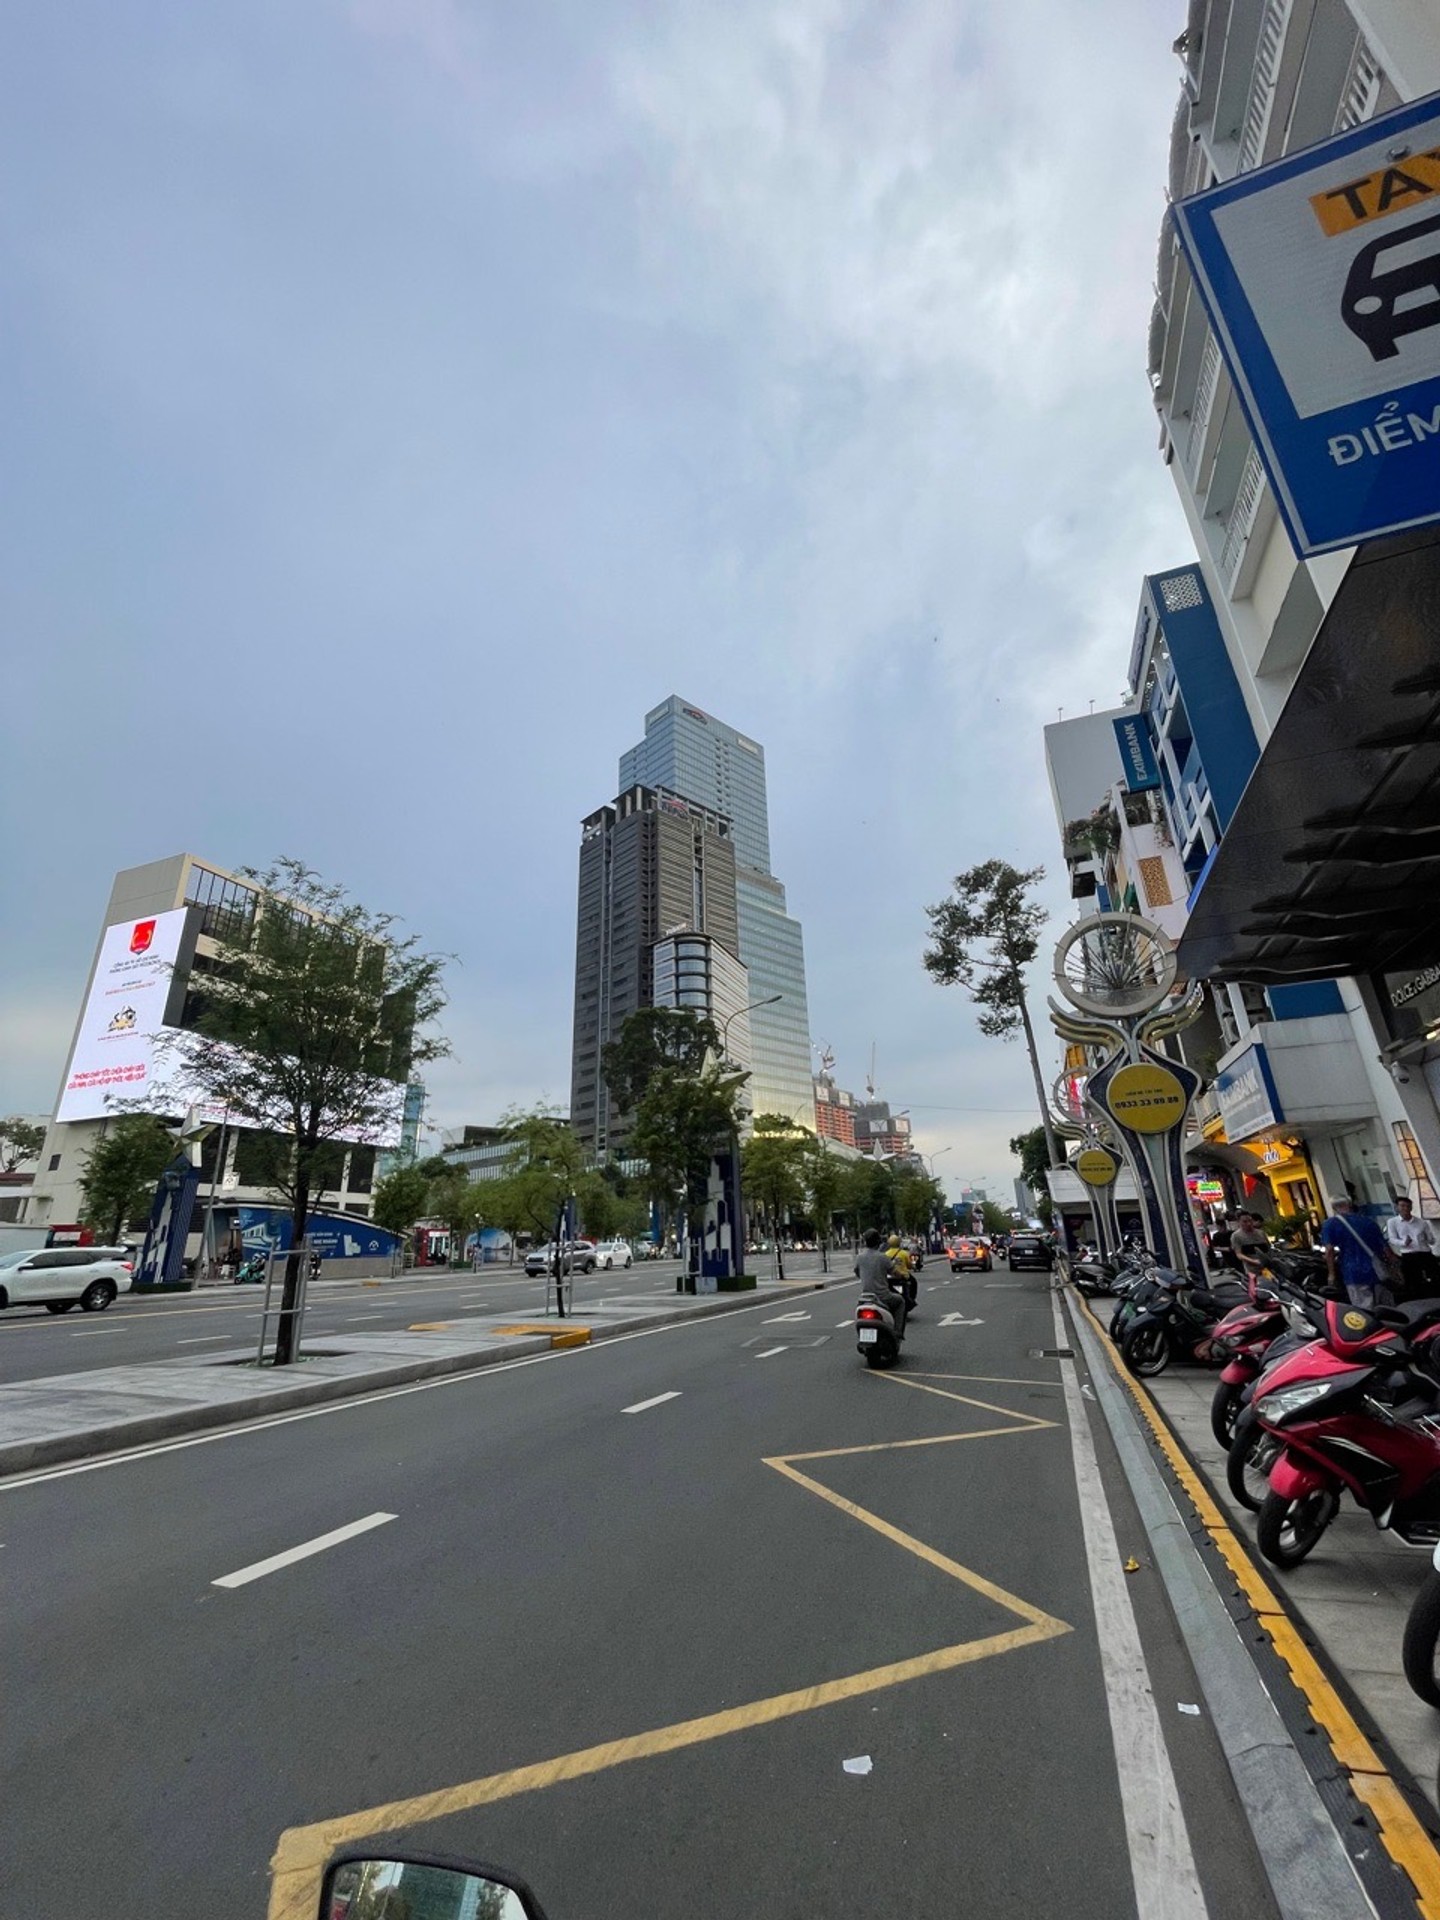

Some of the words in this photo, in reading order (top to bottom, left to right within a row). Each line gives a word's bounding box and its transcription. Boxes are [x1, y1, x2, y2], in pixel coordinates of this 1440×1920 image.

[1326, 152, 1440, 219] TA
[1327, 400, 1440, 466] ĐIỂM
[1123, 722, 1148, 781] EXIMBANK
